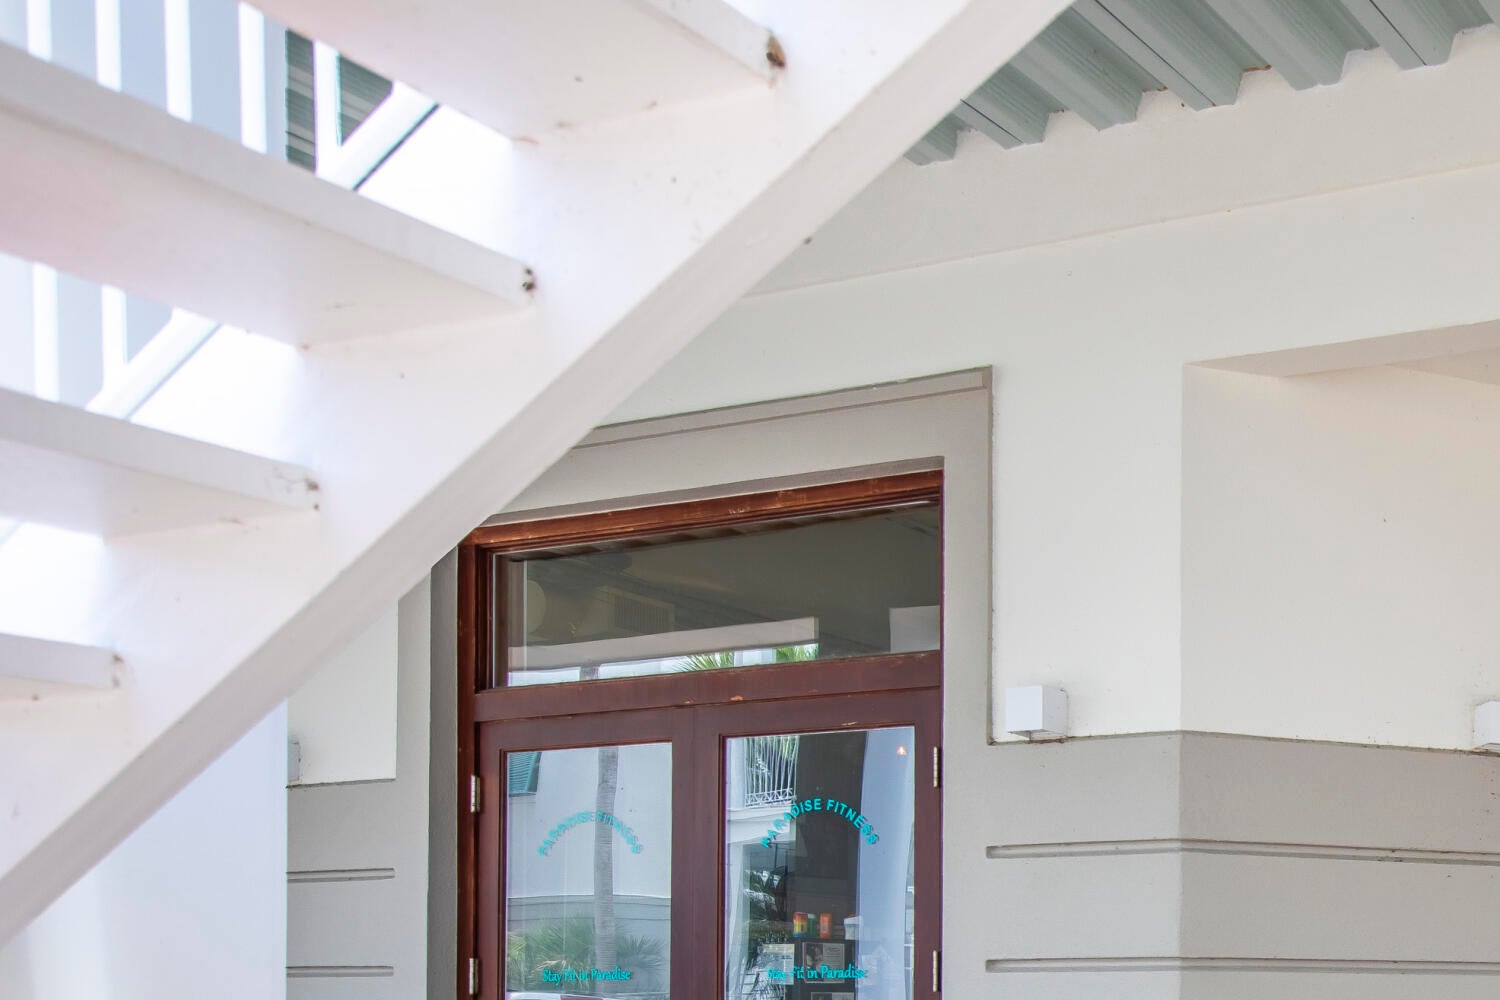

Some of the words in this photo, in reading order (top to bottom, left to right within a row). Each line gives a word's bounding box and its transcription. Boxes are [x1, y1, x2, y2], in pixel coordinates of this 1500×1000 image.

[761, 797, 822, 849] PARADISE
[826, 799, 879, 845] FITNESS
[542, 967, 562, 986] Stay
[563, 967, 576, 982] Fit
[579, 968, 589, 981] in
[590, 965, 631, 981] Paradise
[791, 965, 805, 979] Fit
[807, 965, 818, 979] in
[820, 962, 867, 979] Paradise
